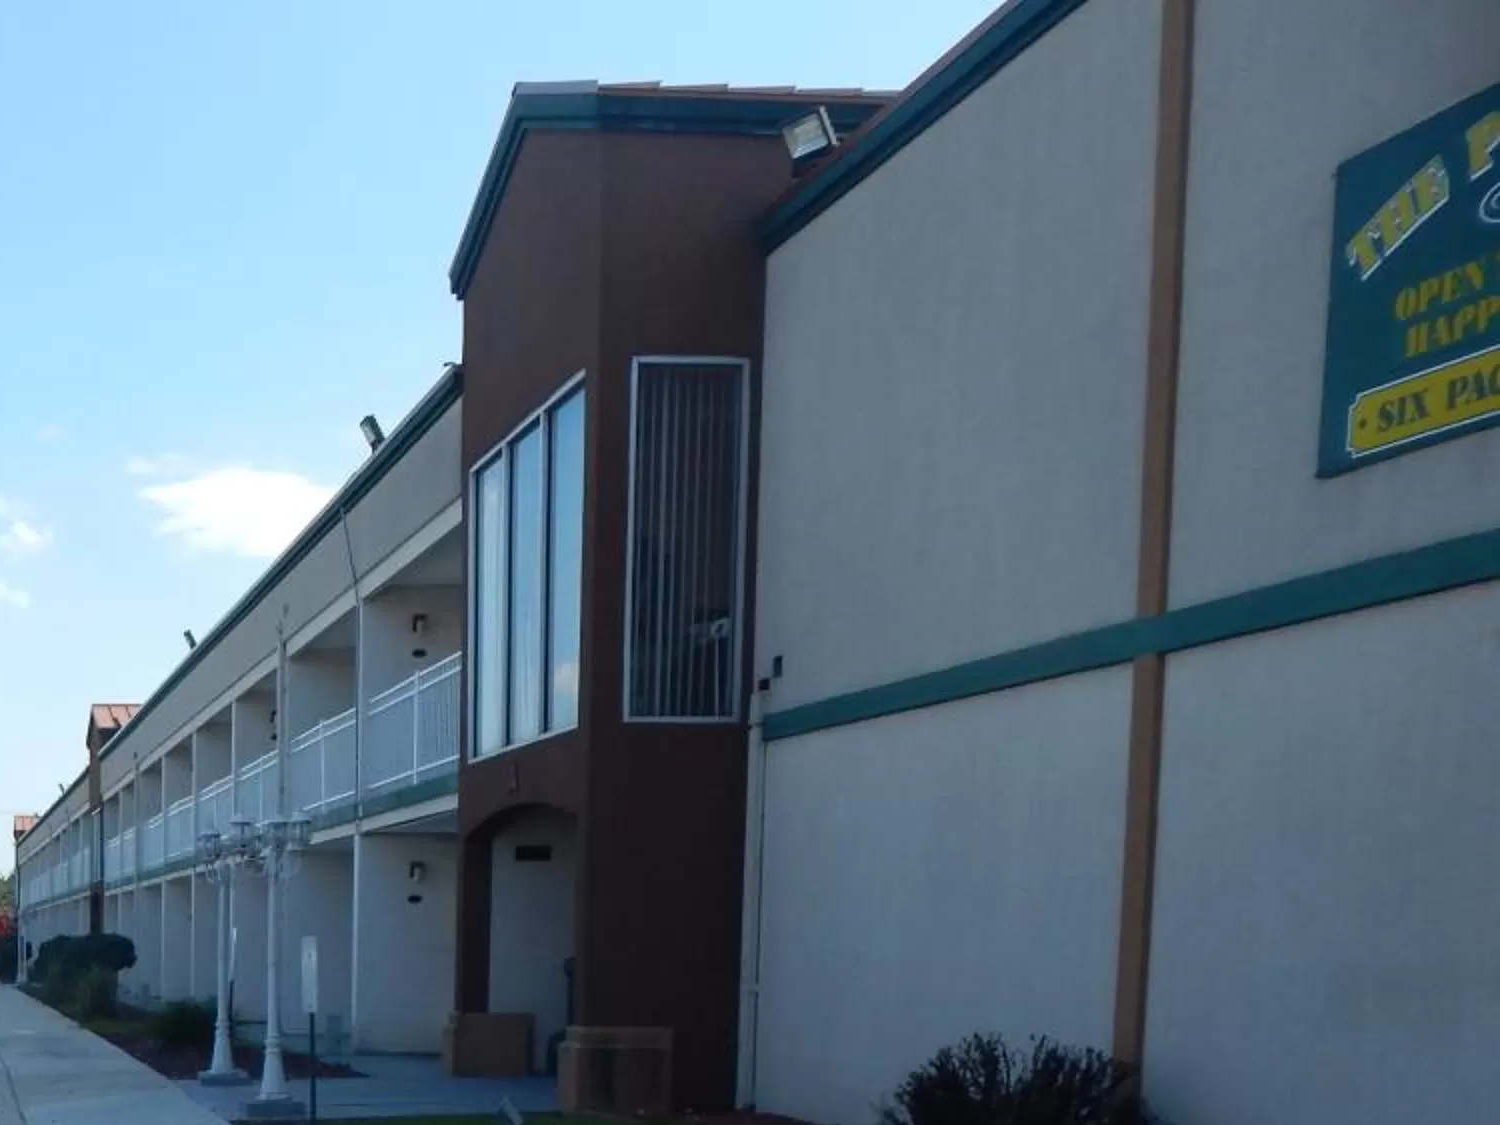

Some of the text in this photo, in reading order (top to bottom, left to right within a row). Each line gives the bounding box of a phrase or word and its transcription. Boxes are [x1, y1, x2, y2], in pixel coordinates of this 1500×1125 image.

[1345, 153, 1450, 281] THE
[1395, 260, 1485, 321] OPEN
[1376, 387, 1430, 434] SIX
